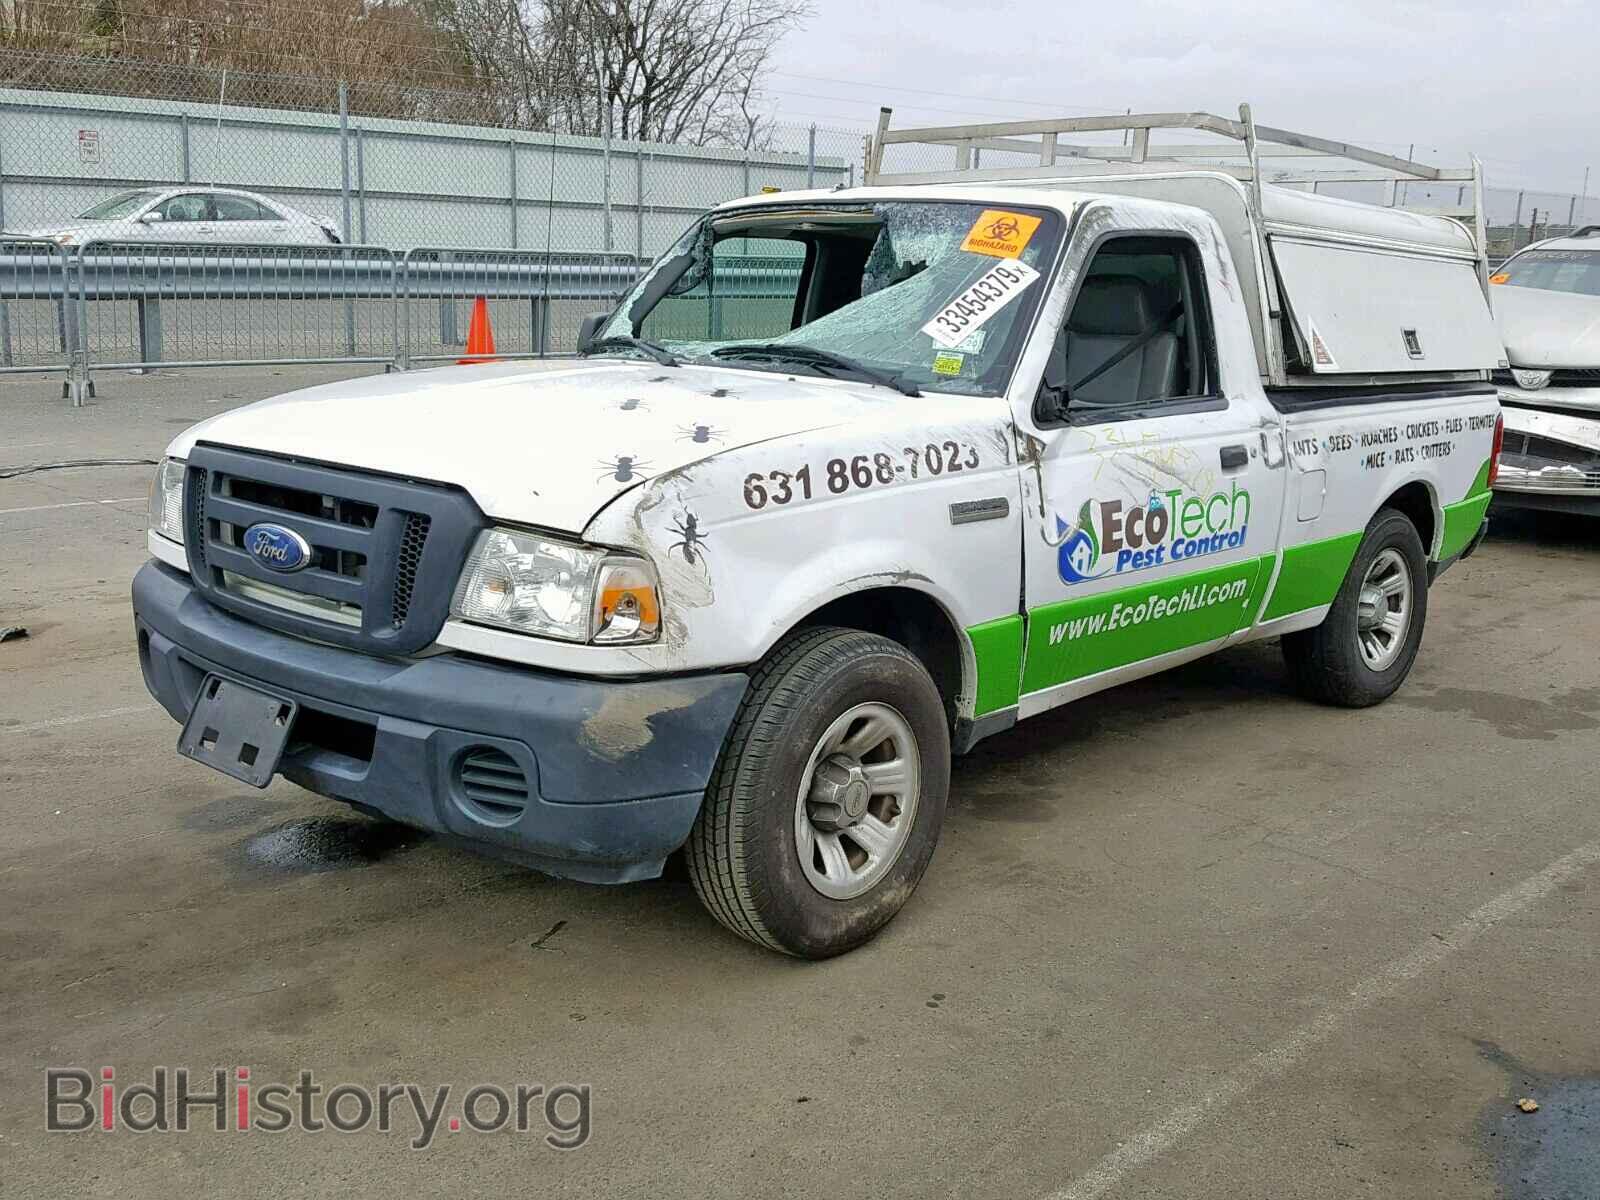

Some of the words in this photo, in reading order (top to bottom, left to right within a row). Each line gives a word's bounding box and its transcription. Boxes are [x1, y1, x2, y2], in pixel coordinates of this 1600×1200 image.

[967, 239, 1018, 253] BIOHAZARD
[936, 266, 1020, 334] 33454379
[1406, 421, 1439, 440] CRICKETS
[1446, 418, 1463, 434] FLIES
[1468, 414, 1496, 431] TERMITES
[1365, 451, 1386, 470] MICE
[1395, 447, 1415, 464] RATS
[1421, 441, 1451, 460] CRITTERS
[743, 464, 812, 510] 631
[826, 440, 980, 494] 868-7023
[253, 530, 289, 561] Ford
[1115, 544, 1165, 573] Pest
[1170, 525, 1247, 561] Control
